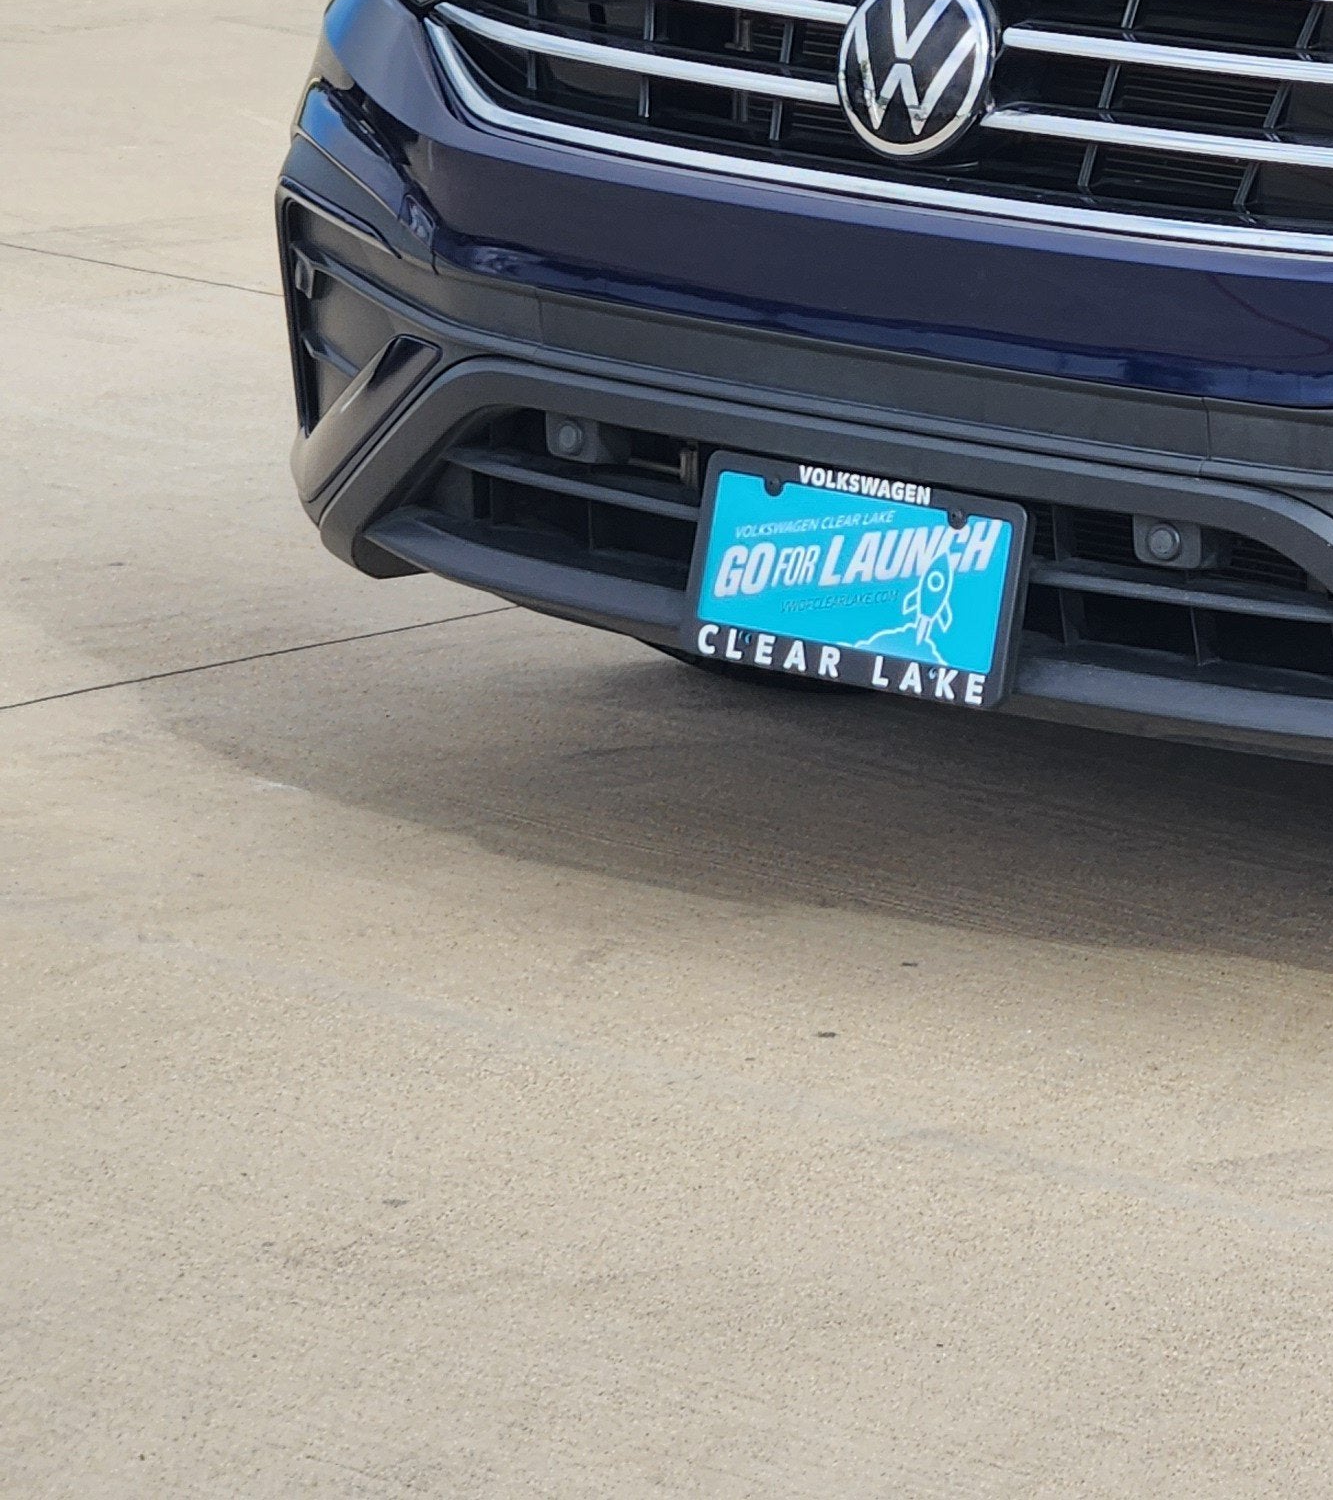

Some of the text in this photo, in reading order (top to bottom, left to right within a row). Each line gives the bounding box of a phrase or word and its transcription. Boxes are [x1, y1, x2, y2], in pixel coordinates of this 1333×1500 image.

[798, 464, 932, 506] VOLKSWAGEN
[735, 510, 897, 539] VOLKSWAGEN CLEAR LAKE
[714, 519, 1003, 598] GO FOR LAUNCH
[697, 623, 987, 706] CLEAR LAKE
